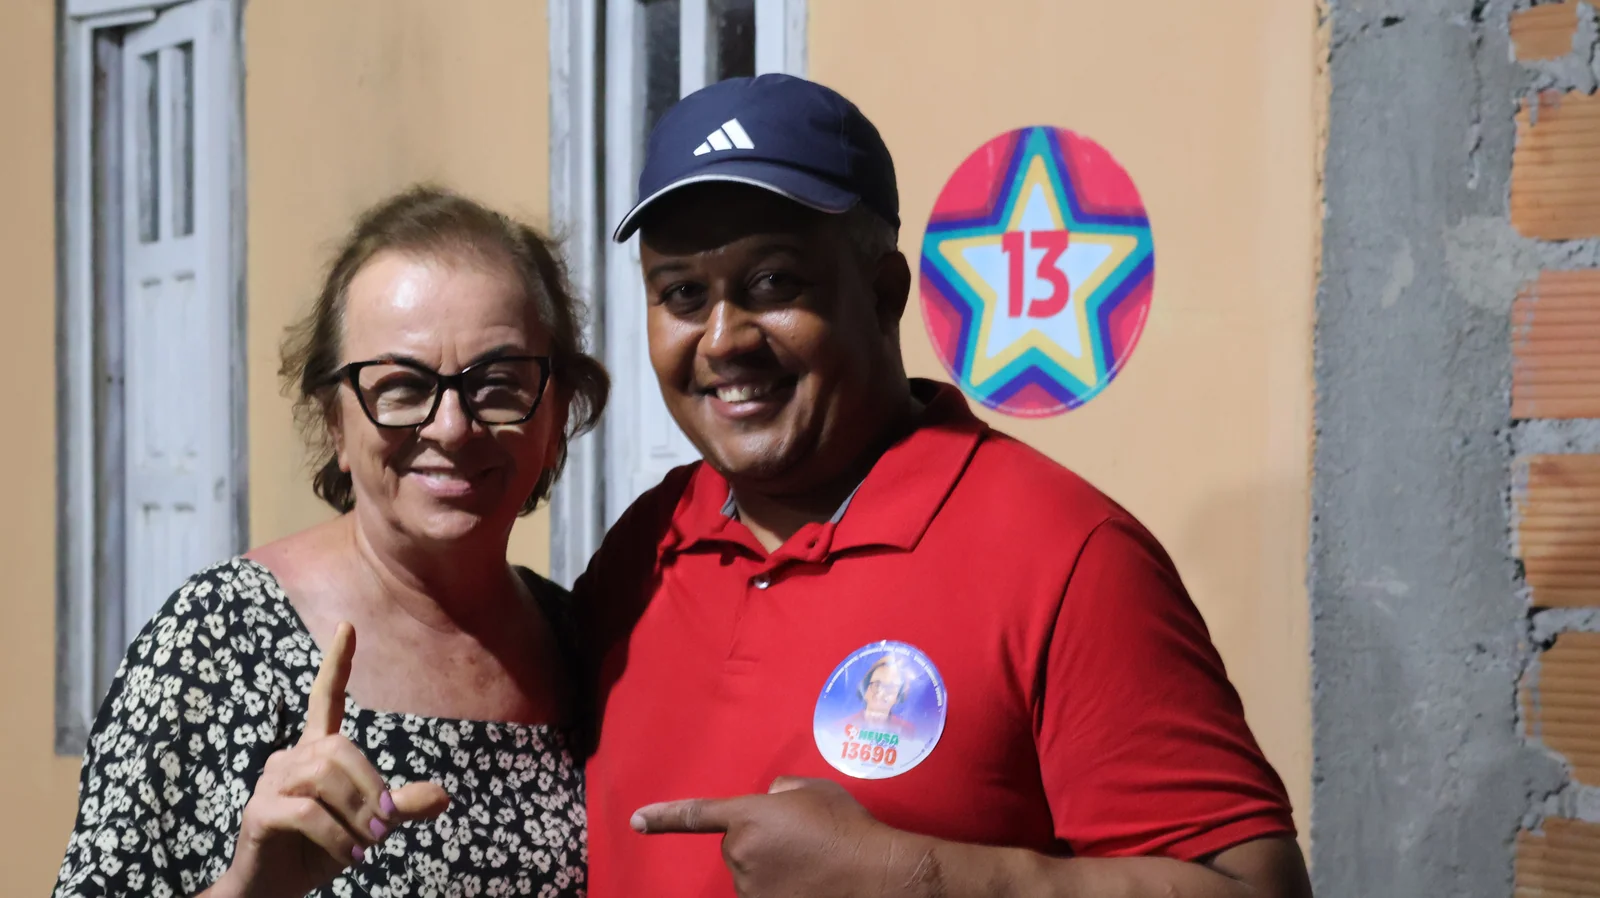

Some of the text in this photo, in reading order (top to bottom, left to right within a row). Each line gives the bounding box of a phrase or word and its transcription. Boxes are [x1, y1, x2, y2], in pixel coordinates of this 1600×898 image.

[1001, 230, 1070, 318] 13
[859, 730, 899, 745] NEUSA
[841, 741, 897, 766] 13690
